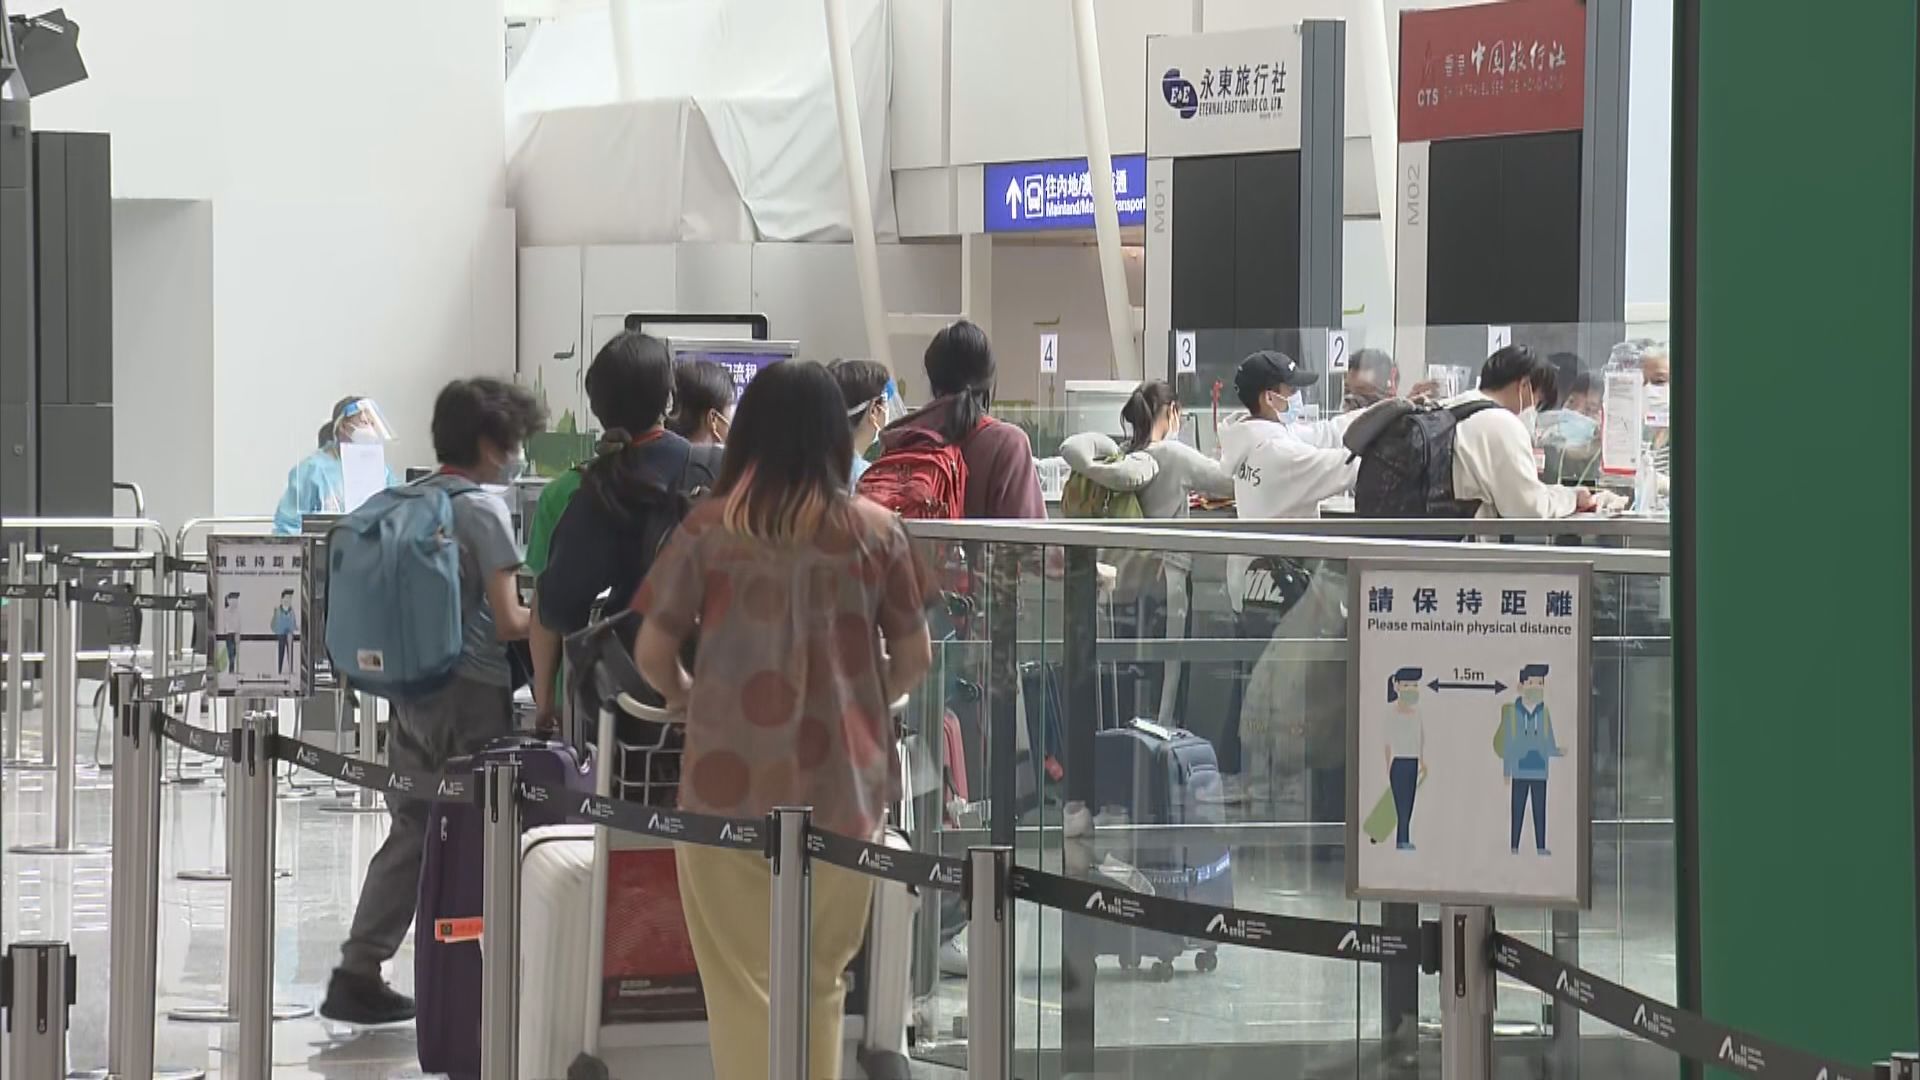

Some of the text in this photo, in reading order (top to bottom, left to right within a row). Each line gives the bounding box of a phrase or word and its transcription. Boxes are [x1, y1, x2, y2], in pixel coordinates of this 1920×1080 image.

[1200, 61, 1287, 99] 永東旅行社
[1199, 101, 1223, 116] ETERNAL
[1224, 100, 1239, 115] EAST
[1239, 99, 1258, 114] TOURS
[1418, 88, 1439, 107] CTS
[1114, 196, 1146, 215] ransport
[1154, 180, 1165, 232] M01
[1407, 163, 1420, 225] M02
[1044, 340, 1053, 367] 4
[1182, 338, 1192, 367] 3
[1334, 336, 1344, 367] 2
[1369, 586, 1573, 617] 請保持距離
[1368, 618, 1572, 635] Please maintain physical distance
[1453, 668, 1485, 681] 1.5m
